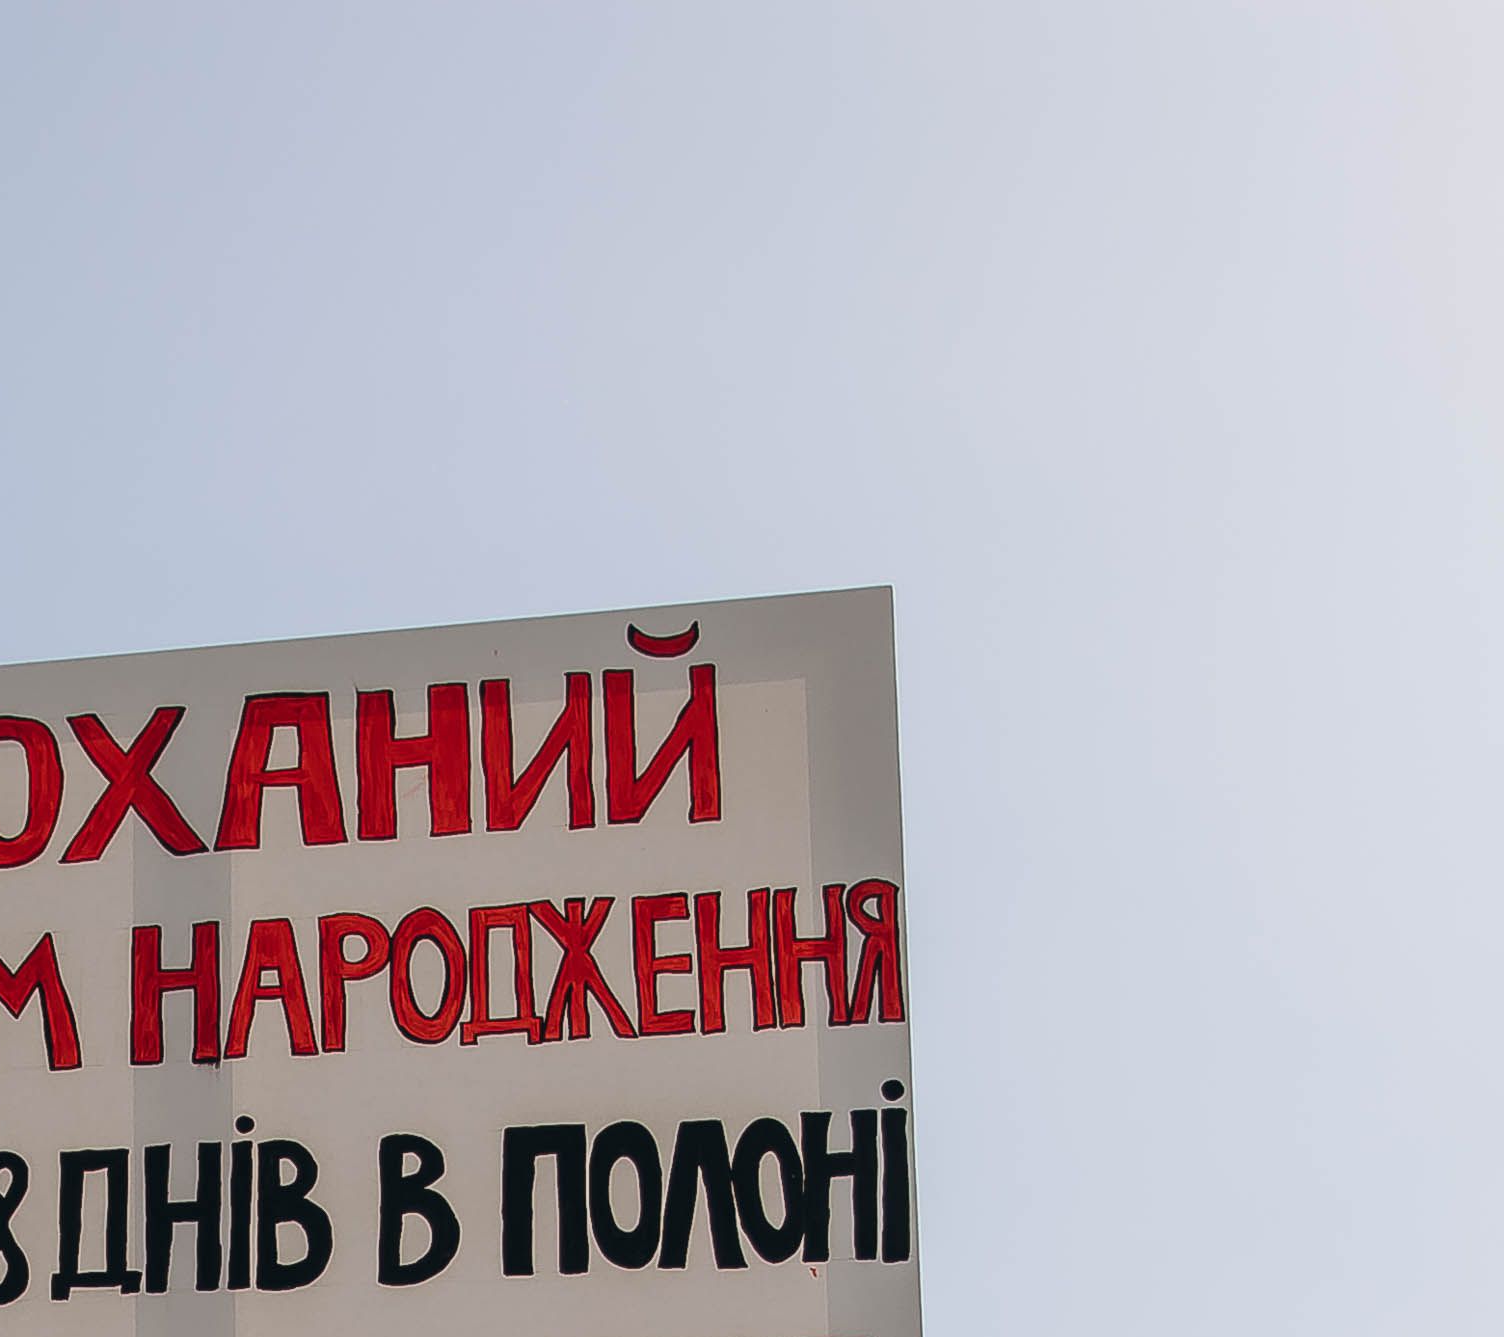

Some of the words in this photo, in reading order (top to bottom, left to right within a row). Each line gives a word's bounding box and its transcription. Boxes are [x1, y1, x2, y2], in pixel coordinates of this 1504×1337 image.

[129, 877, 906, 1065] НАРОДЖЕННЯ
[50, 1115, 332, 1302] ДНІВ
[377, 1131, 460, 1285] В
[500, 1078, 913, 1278] ПОЛОНІ
